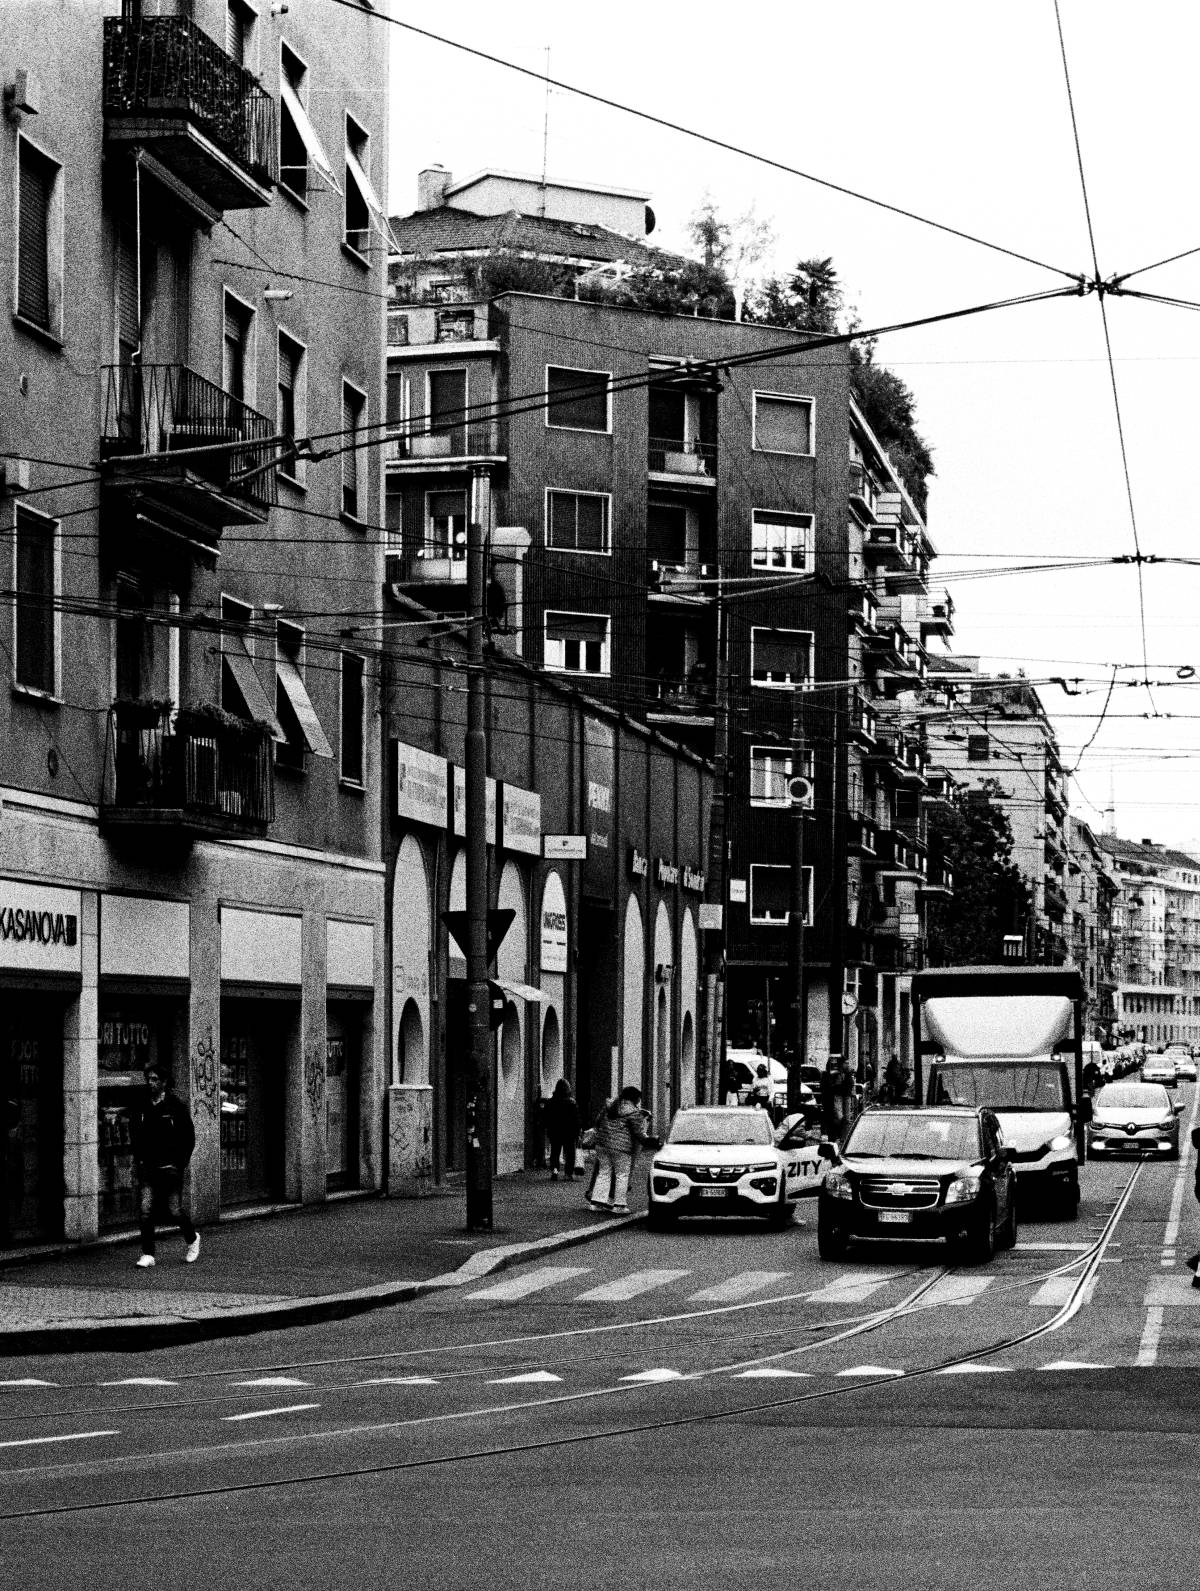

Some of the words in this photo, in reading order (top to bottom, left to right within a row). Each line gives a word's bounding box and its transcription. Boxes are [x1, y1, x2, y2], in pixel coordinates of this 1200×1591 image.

[0, 906, 67, 945] KASANOVA
[116, 1022, 149, 1045] TUTTO
[787, 1159, 822, 1178] ZITY
